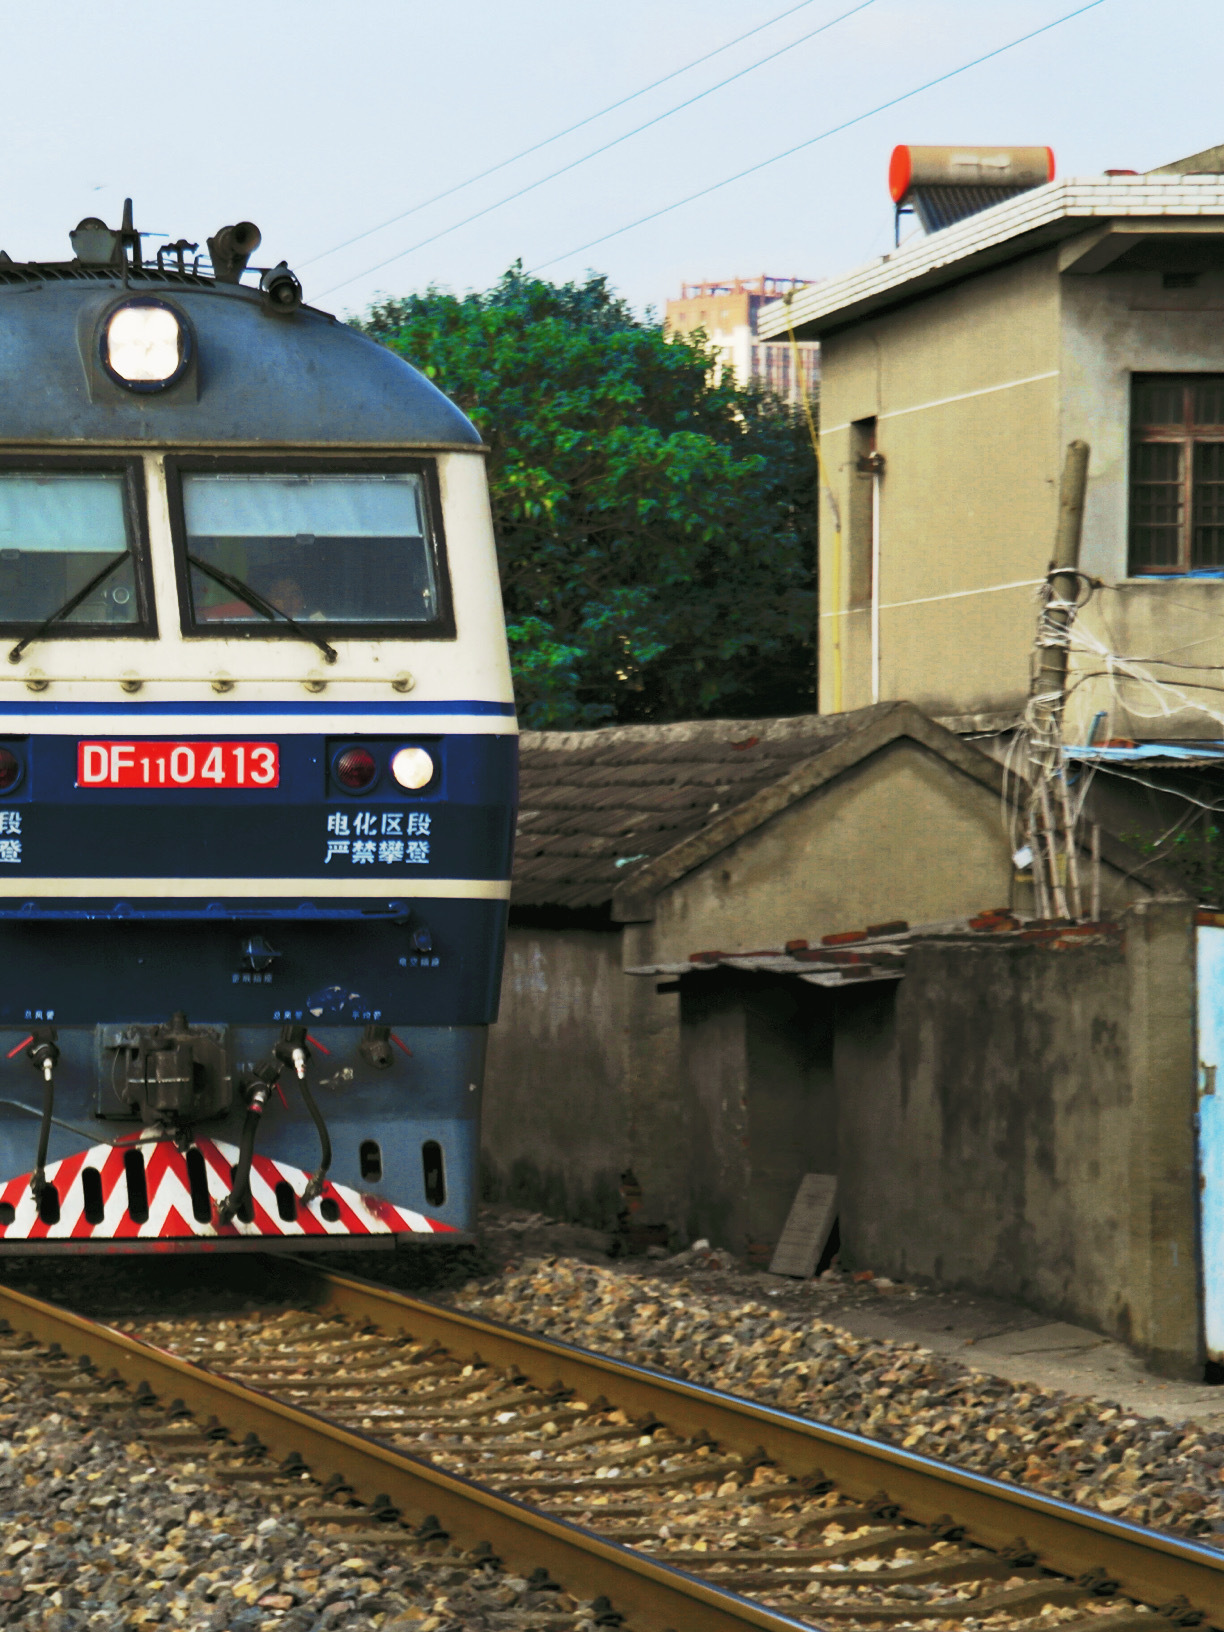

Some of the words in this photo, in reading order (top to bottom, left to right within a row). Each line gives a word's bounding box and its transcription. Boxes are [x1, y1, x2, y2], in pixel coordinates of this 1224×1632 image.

[83, 745, 275, 784] DF110413
[326, 811, 432, 836] 电化区段
[324, 839, 431, 865] 严禁攀登
